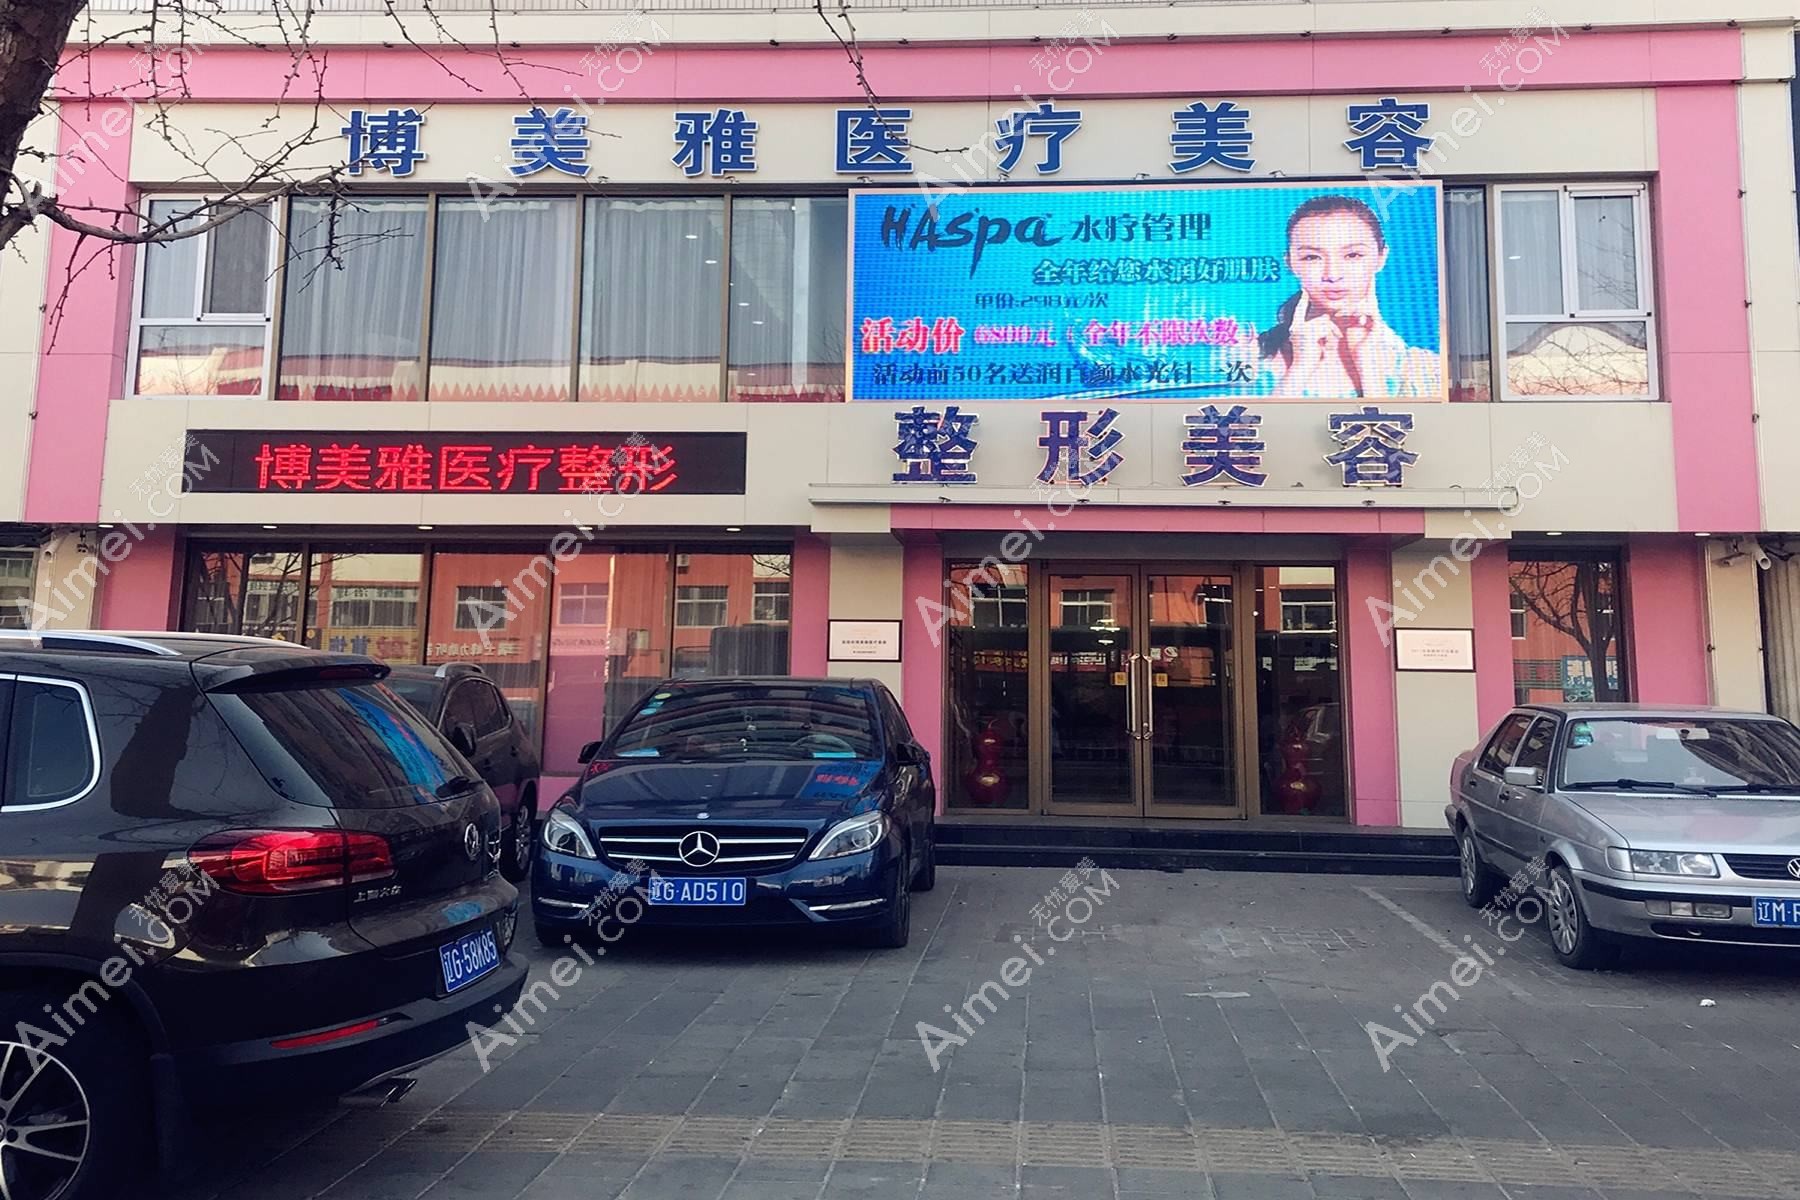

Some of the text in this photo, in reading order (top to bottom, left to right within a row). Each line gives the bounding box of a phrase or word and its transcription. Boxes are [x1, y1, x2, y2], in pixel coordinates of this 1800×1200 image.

[340, 97, 1435, 177] 博美雅医疗美容
[1071, 213, 1212, 244] 水疗管理
[860, 316, 966, 355] 活动价
[254, 443, 679, 492] 博美雅医疗整形
[891, 404, 1420, 487] 整形美容
